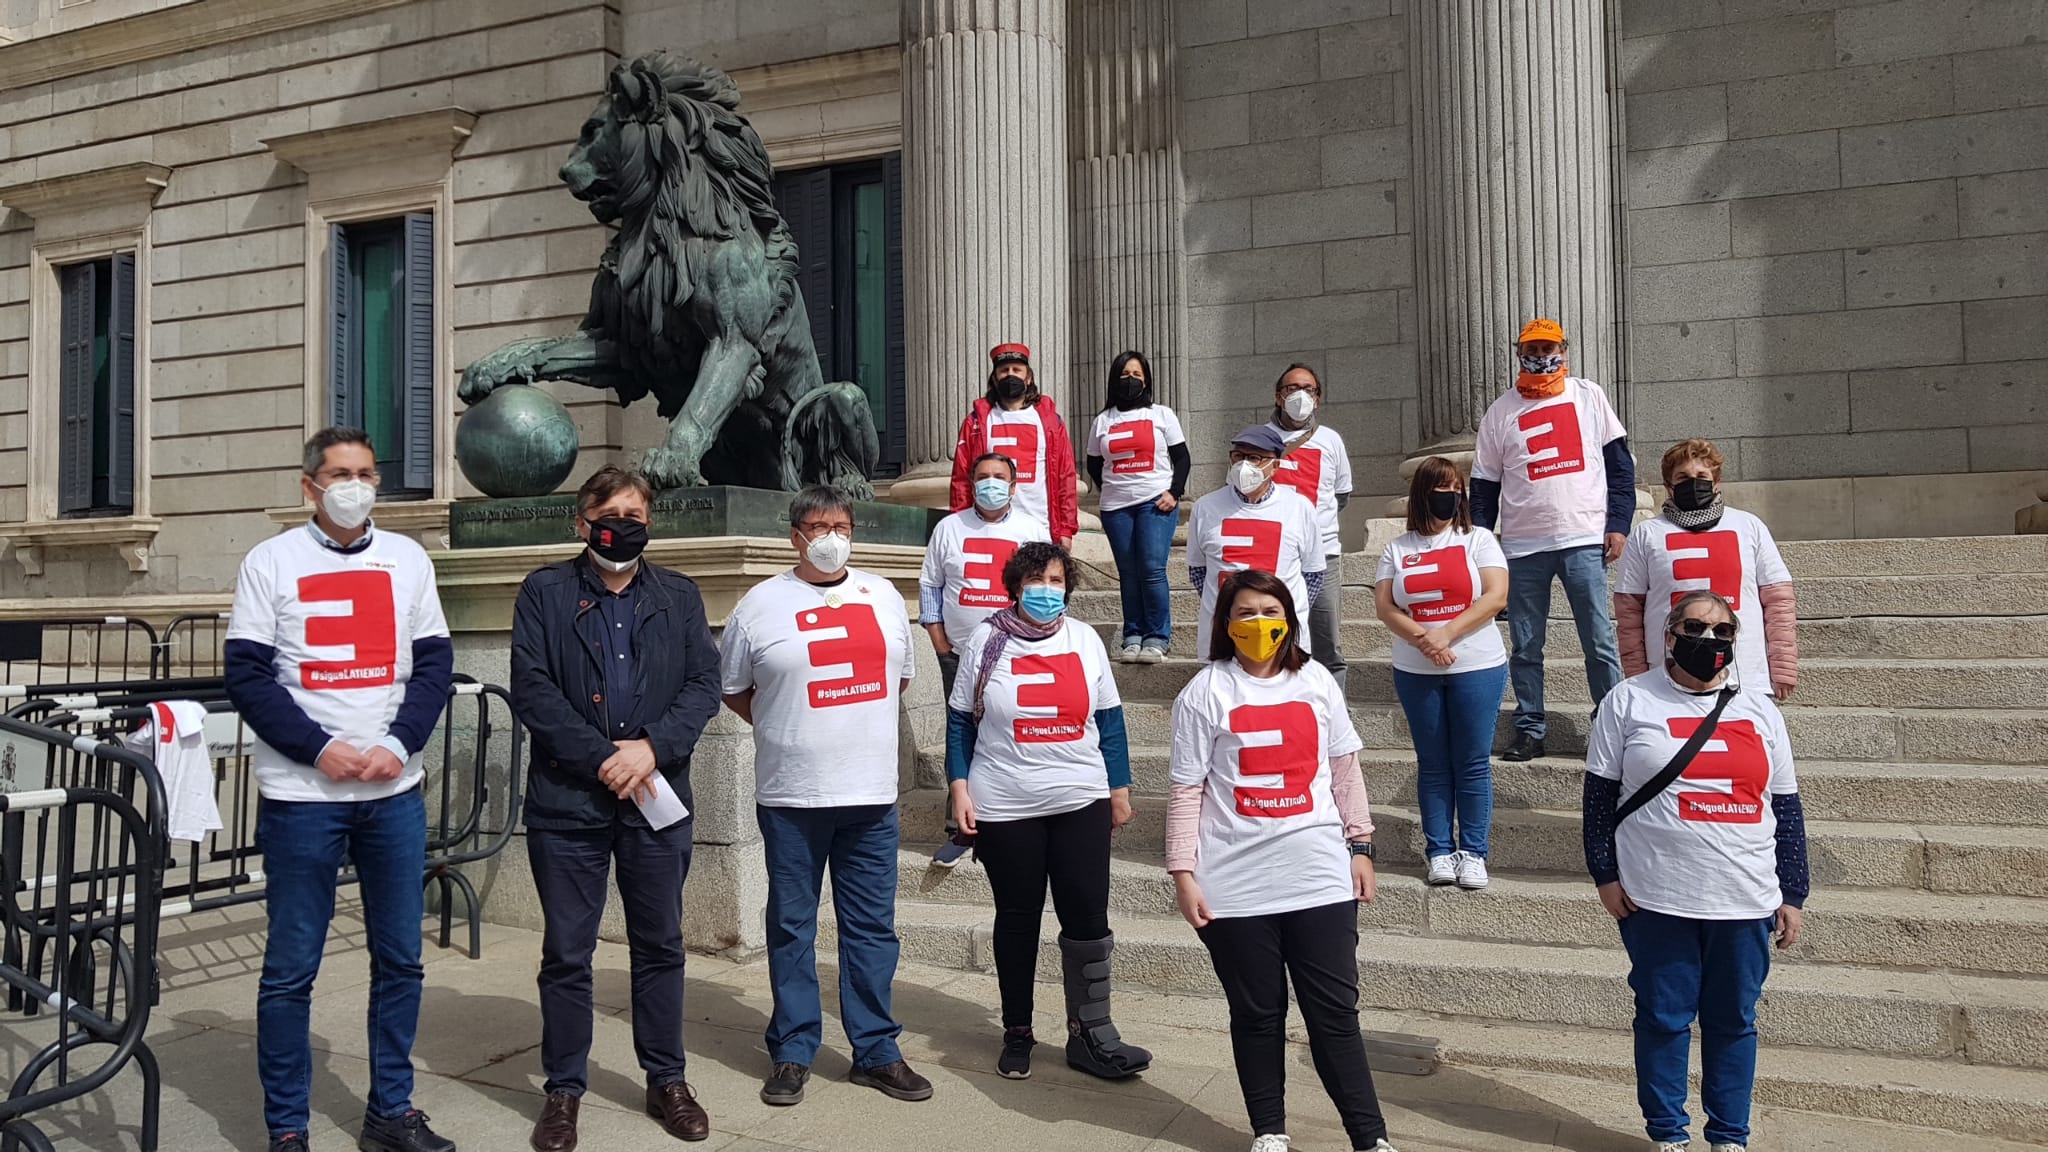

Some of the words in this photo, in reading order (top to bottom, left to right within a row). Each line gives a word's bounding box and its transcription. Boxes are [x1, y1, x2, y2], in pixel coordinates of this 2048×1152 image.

[1534, 459, 1580, 474] #sigueLATIENDO
[310, 666, 388, 683] #sigueLATIENDO
[817, 682, 881, 699] #sigueLATIENDO
[1689, 800, 1759, 814] #sigueLATIENDO
